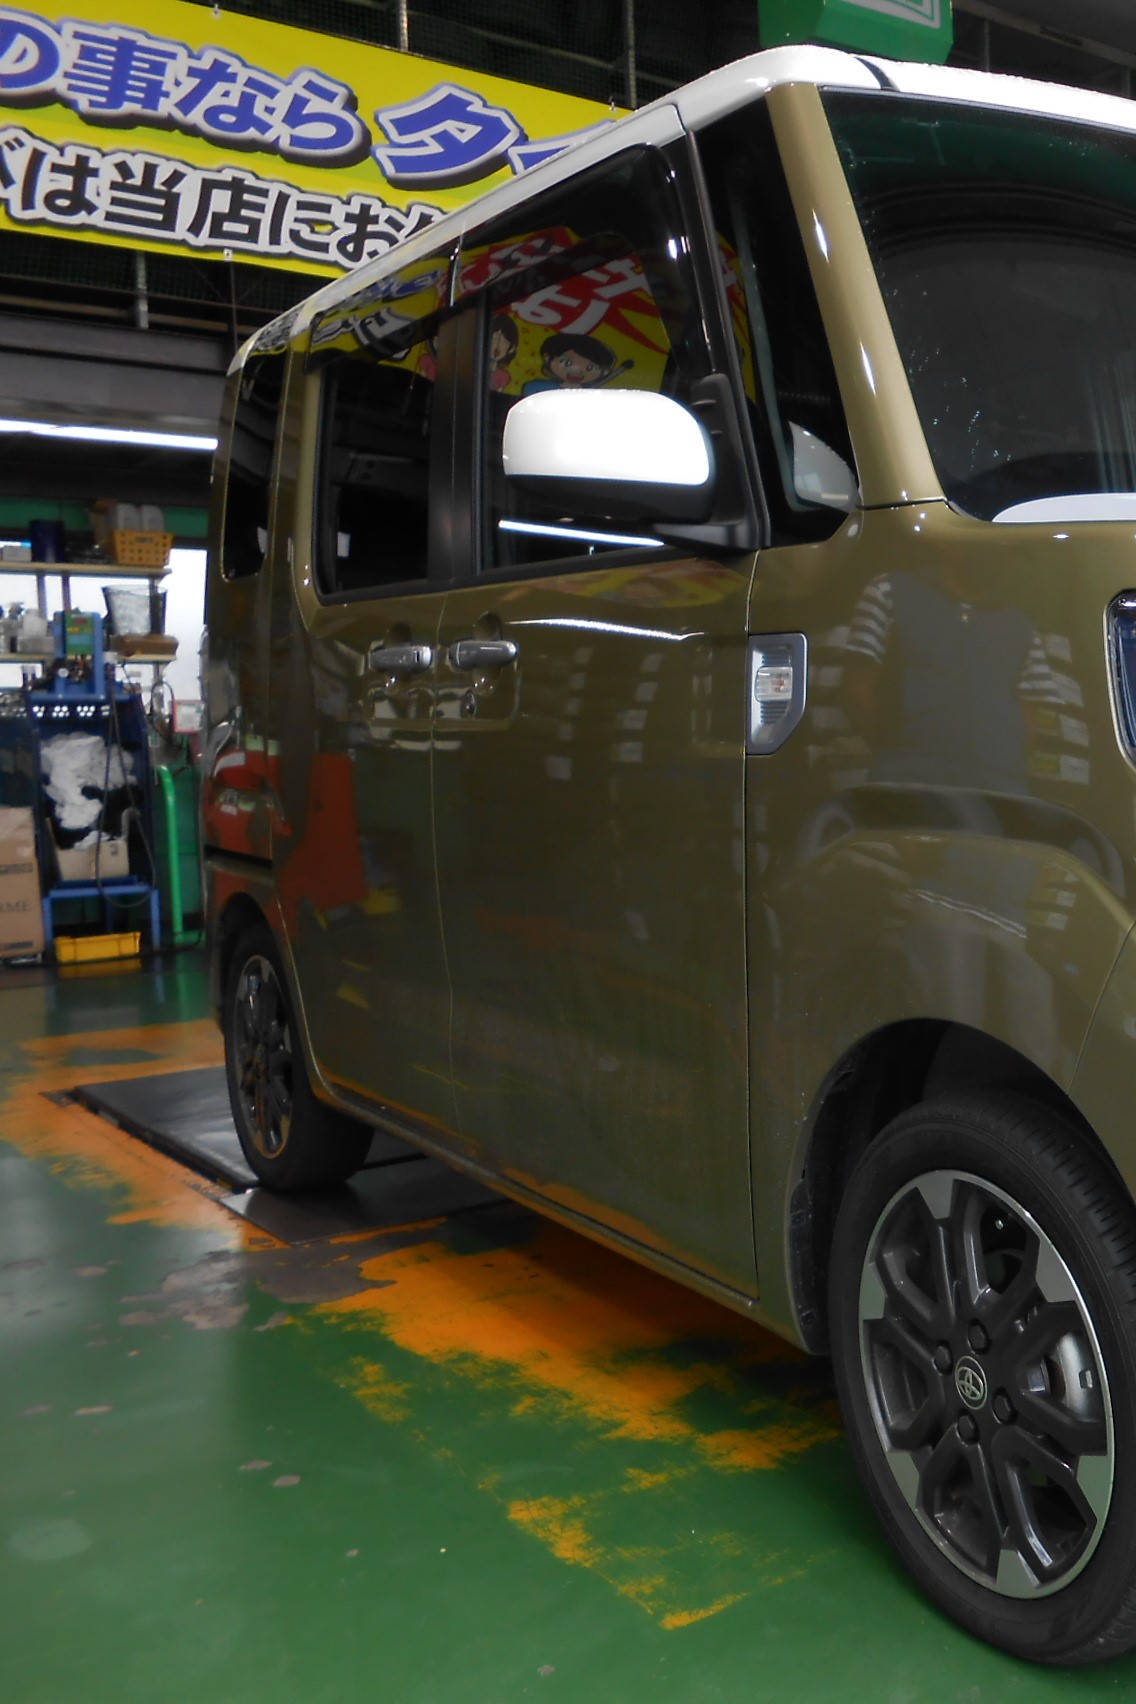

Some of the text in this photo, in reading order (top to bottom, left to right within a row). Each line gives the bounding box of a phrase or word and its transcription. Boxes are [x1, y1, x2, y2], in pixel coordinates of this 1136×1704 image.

[0, 135, 436, 261] は当店にお
